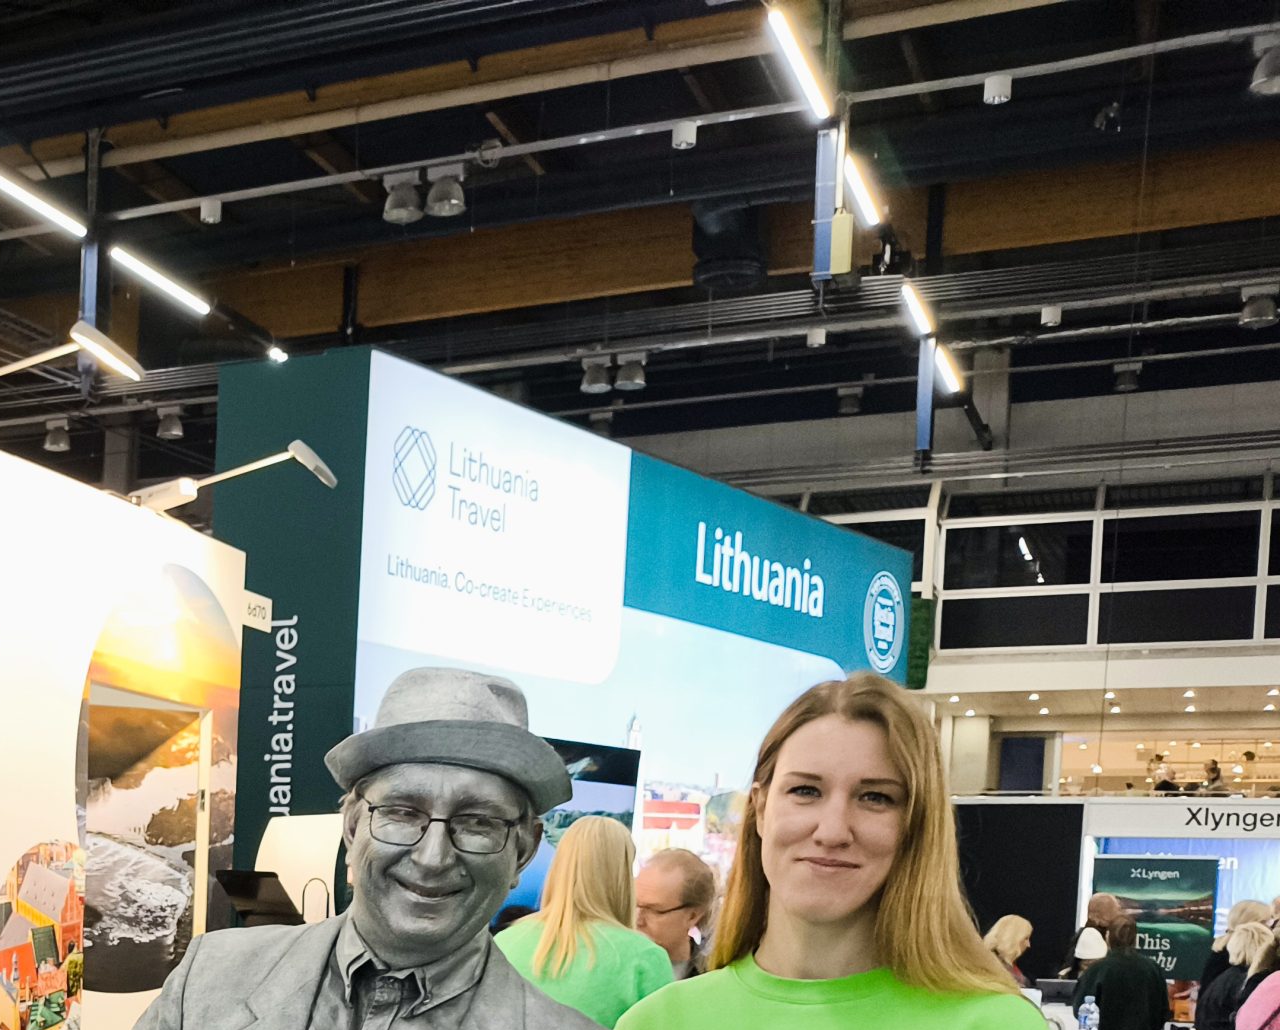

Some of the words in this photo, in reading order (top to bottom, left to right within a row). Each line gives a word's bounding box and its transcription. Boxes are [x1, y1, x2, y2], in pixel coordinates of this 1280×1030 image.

[449, 442, 539, 501] Lithuania
[448, 485, 506, 532] Travel
[455, 571, 519, 605] Co-create
[695, 521, 824, 617] Lithuania
[1185, 807, 1280, 831] Xlynge
[1144, 952, 1177, 971] hy
